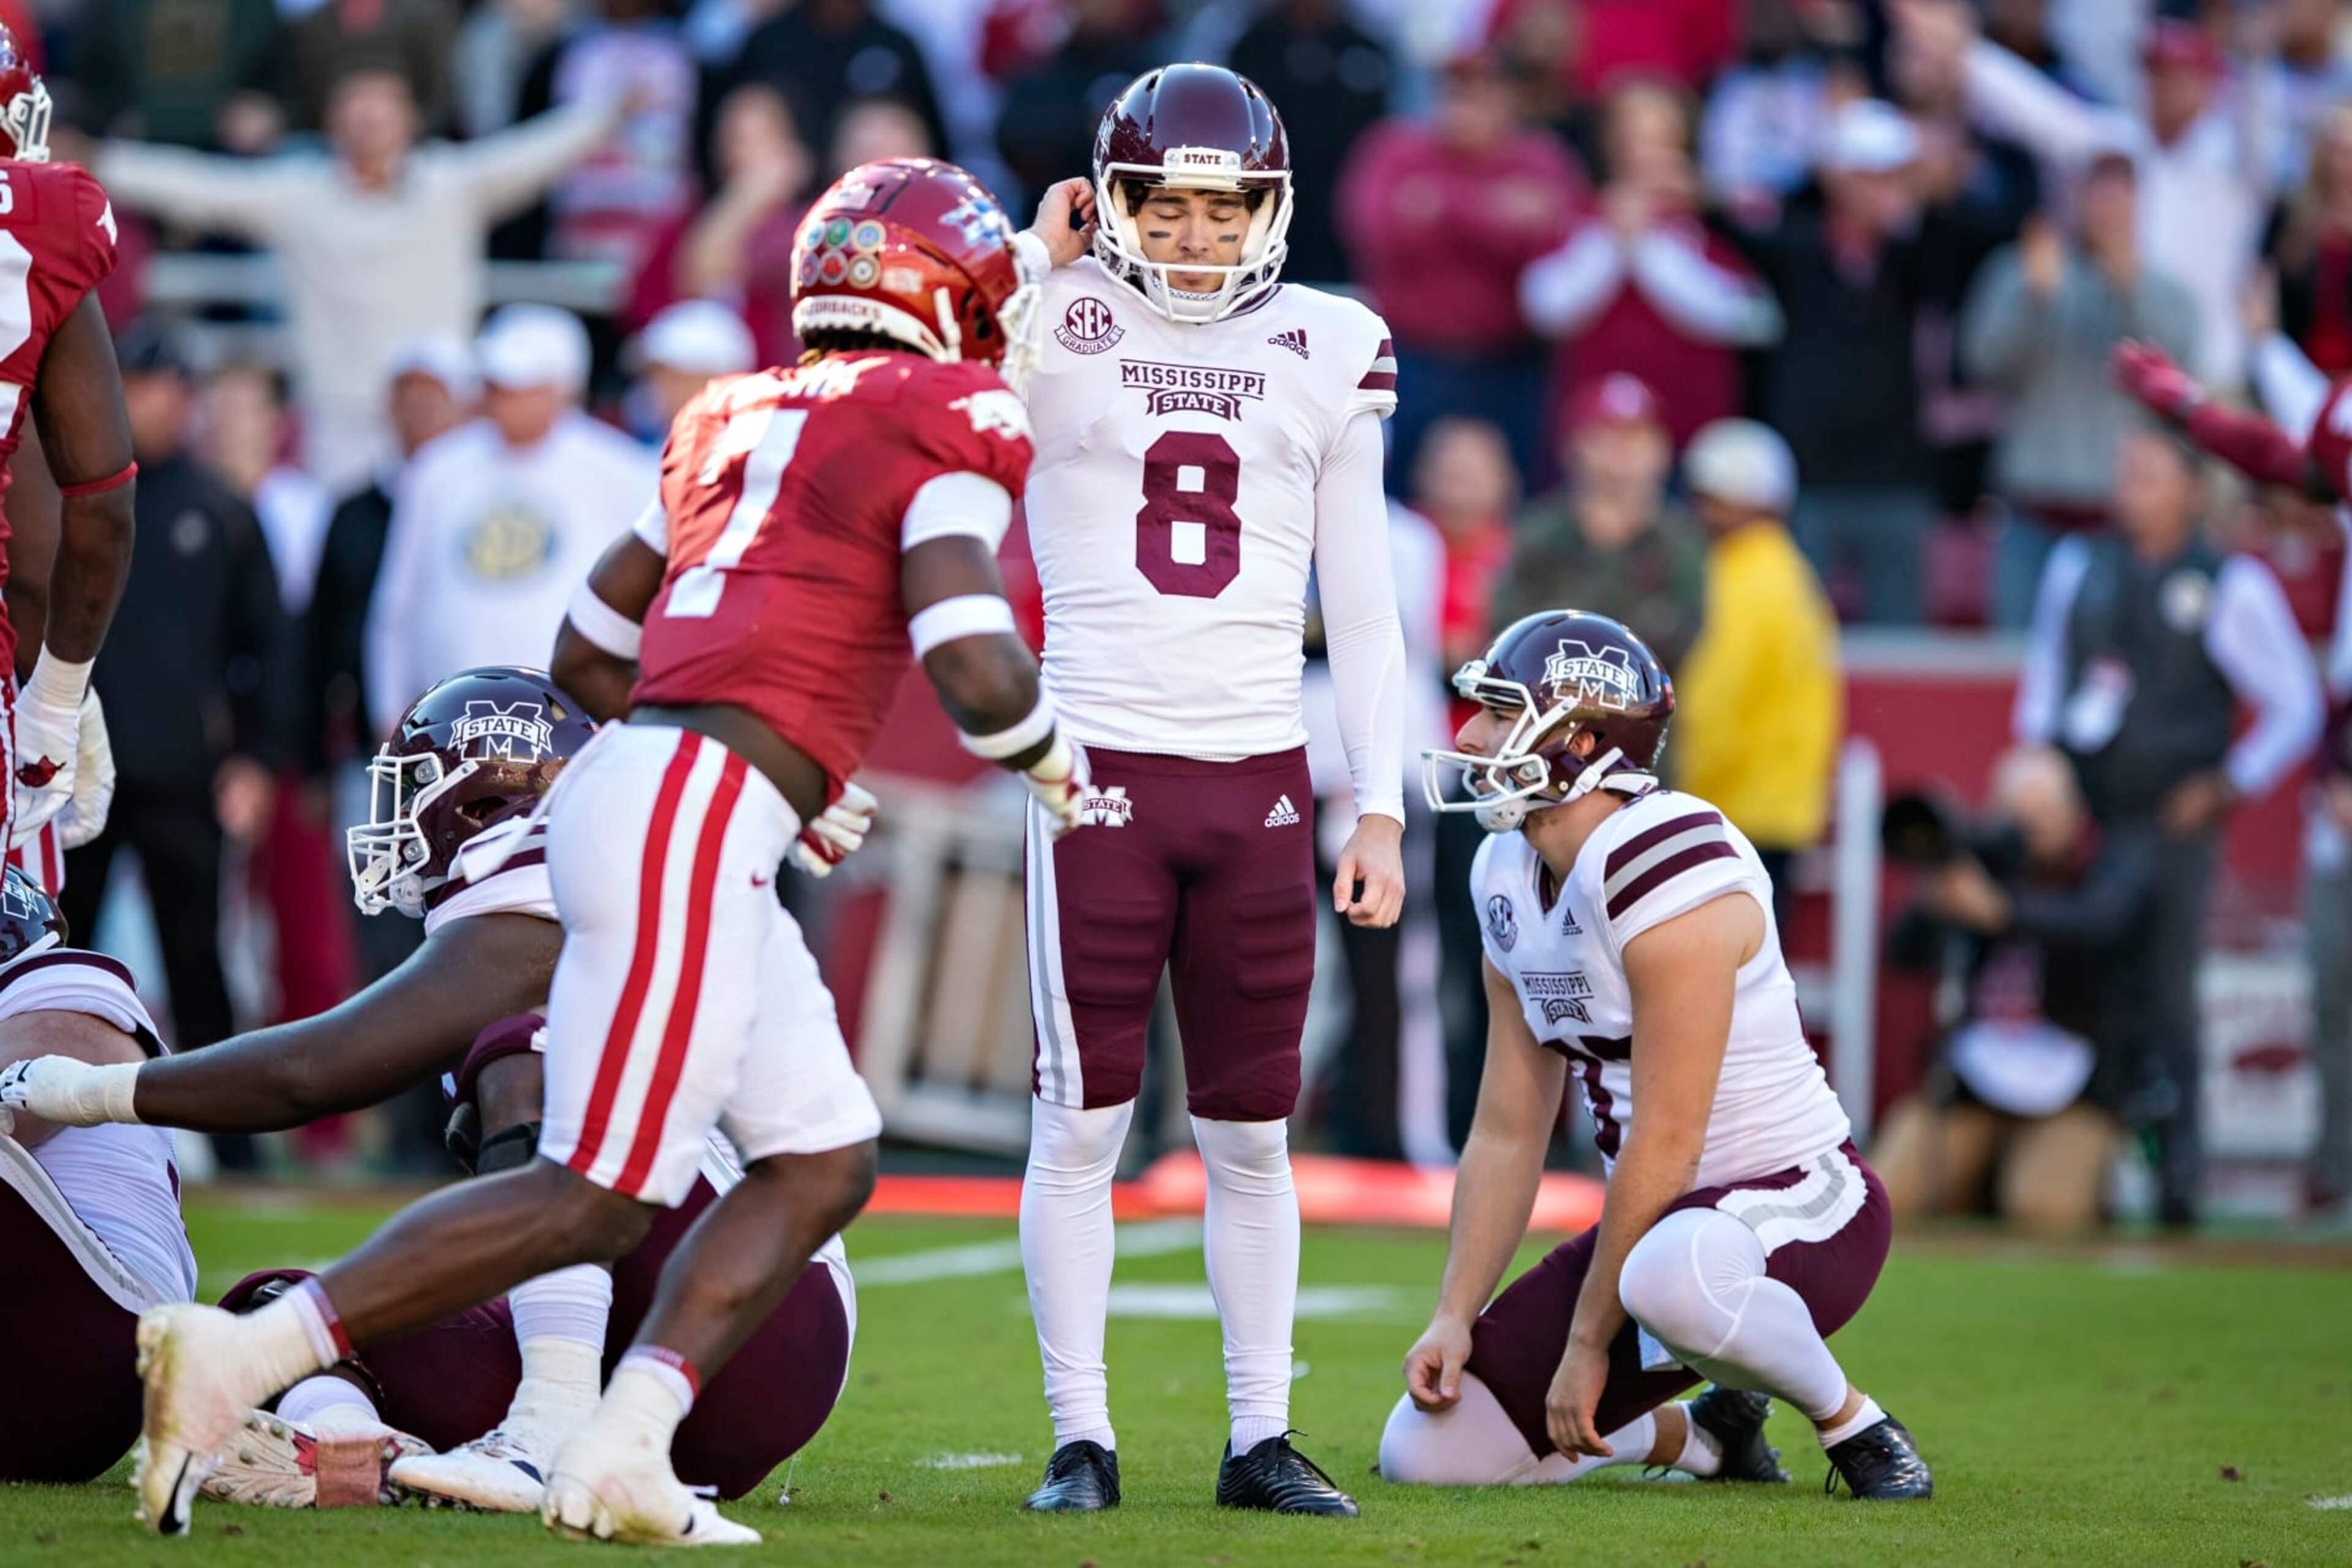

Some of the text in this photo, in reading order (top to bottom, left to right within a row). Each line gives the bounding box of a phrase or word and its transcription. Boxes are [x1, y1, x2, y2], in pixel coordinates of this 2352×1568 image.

[1184, 154, 1221, 164] STATE
[1067, 298, 1110, 339] SEC
[1063, 335, 1115, 352] GRADUATE
[1267, 337, 1310, 360] adidas
[1121, 364, 1265, 395] MISSISSIPPI
[1163, 393, 1224, 416] STATE
[664, 409, 809, 617] 7
[1136, 431, 1242, 599] 8
[1564, 660, 1622, 684] STATE
[469, 718, 532, 739] STATE
[1083, 799, 1121, 812] STATE
[1264, 813, 1300, 827] adidas
[1522, 976, 1591, 995] MISSISSIPPI
